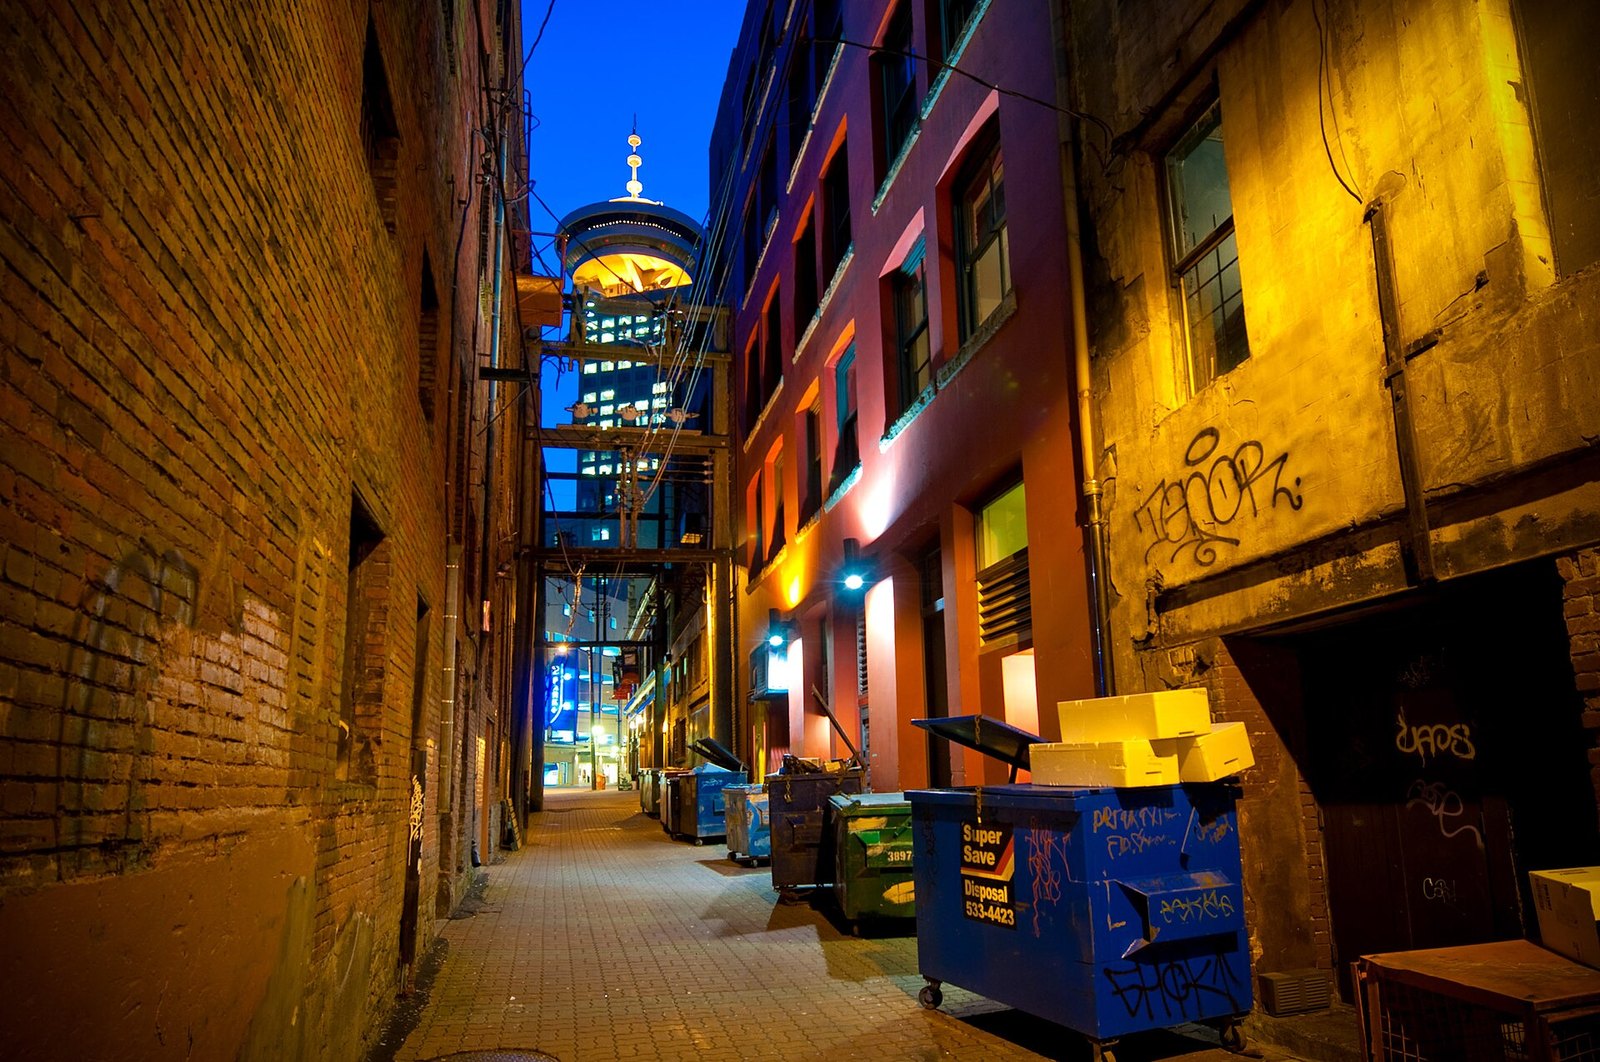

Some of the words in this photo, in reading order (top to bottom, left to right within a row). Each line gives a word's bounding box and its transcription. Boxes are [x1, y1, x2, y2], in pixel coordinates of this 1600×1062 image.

[963, 824, 1002, 847] Super
[887, 850, 912, 862] 3897
[963, 845, 996, 866] Save
[964, 879, 1008, 903] Disposal
[965, 901, 1015, 926] 533-4423
